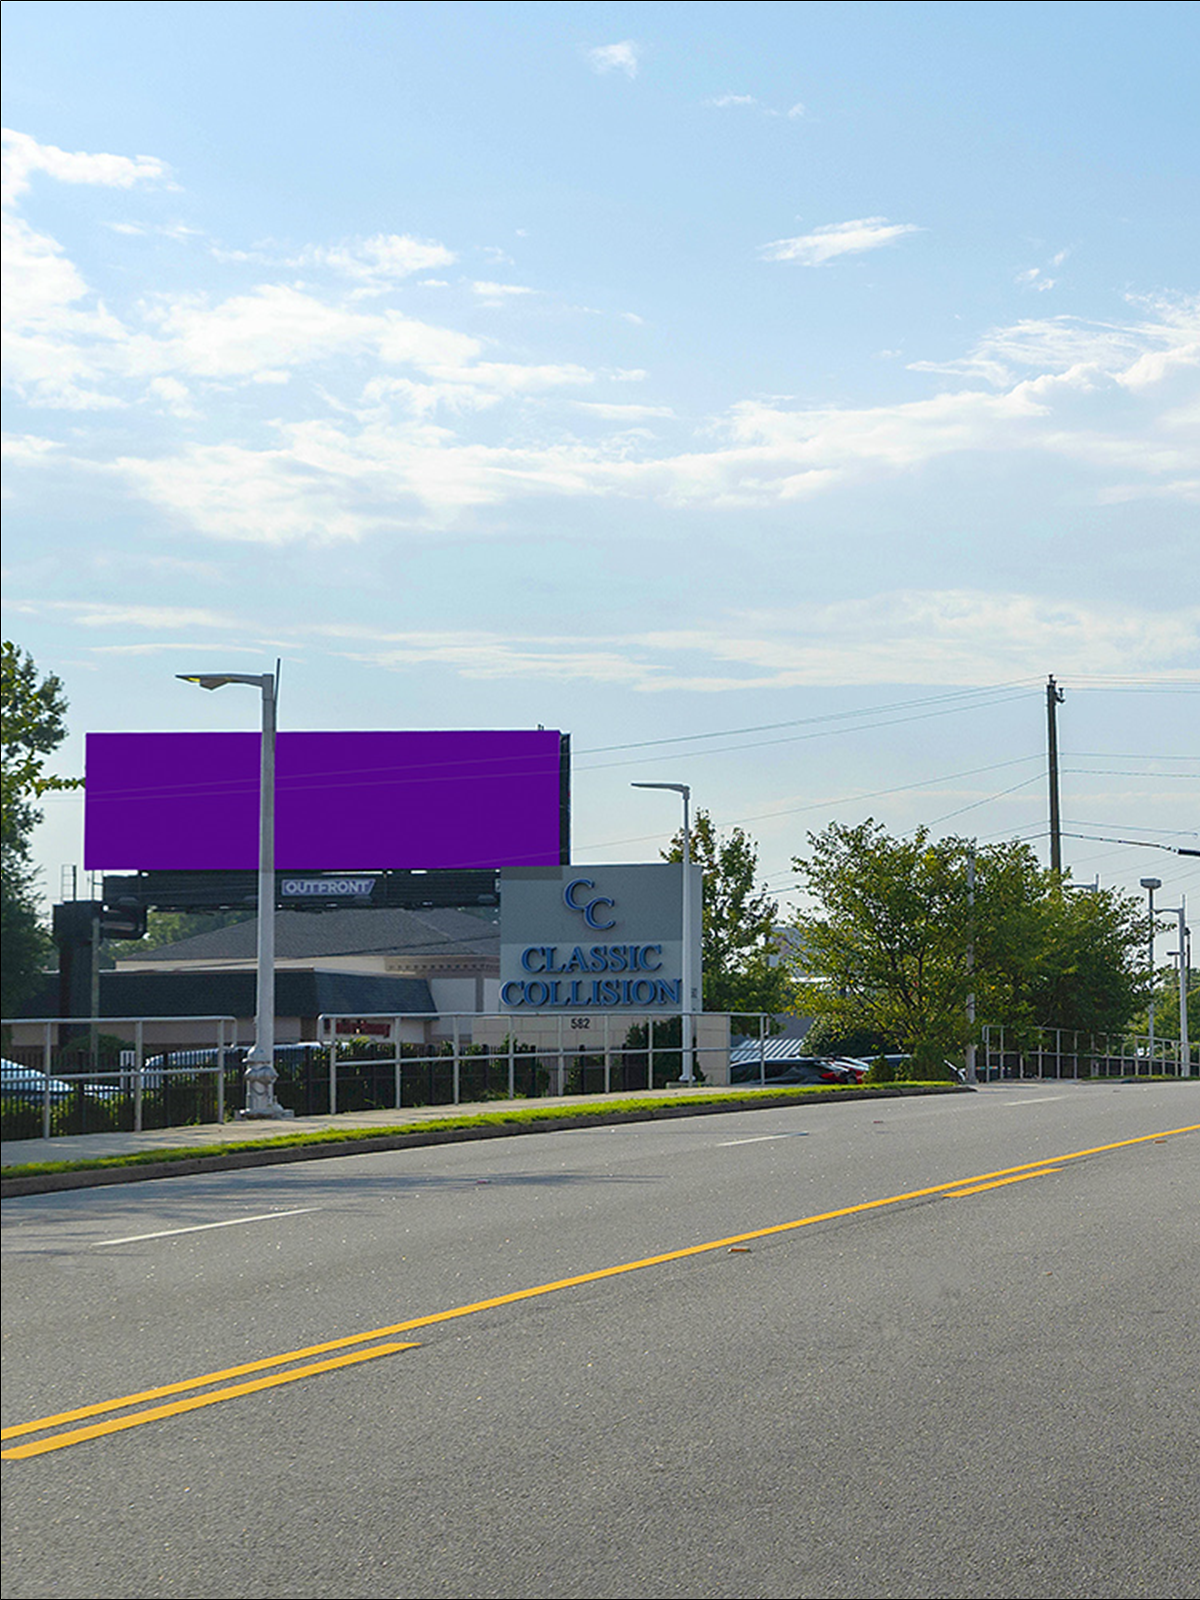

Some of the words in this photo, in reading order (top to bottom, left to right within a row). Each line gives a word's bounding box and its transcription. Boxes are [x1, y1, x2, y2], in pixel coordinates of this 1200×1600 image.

[285, 880, 370, 894] OUTFRONT
[521, 944, 664, 974] CLASSIC
[500, 978, 683, 1007] COLLISION
[570, 1017, 591, 1030] 582
